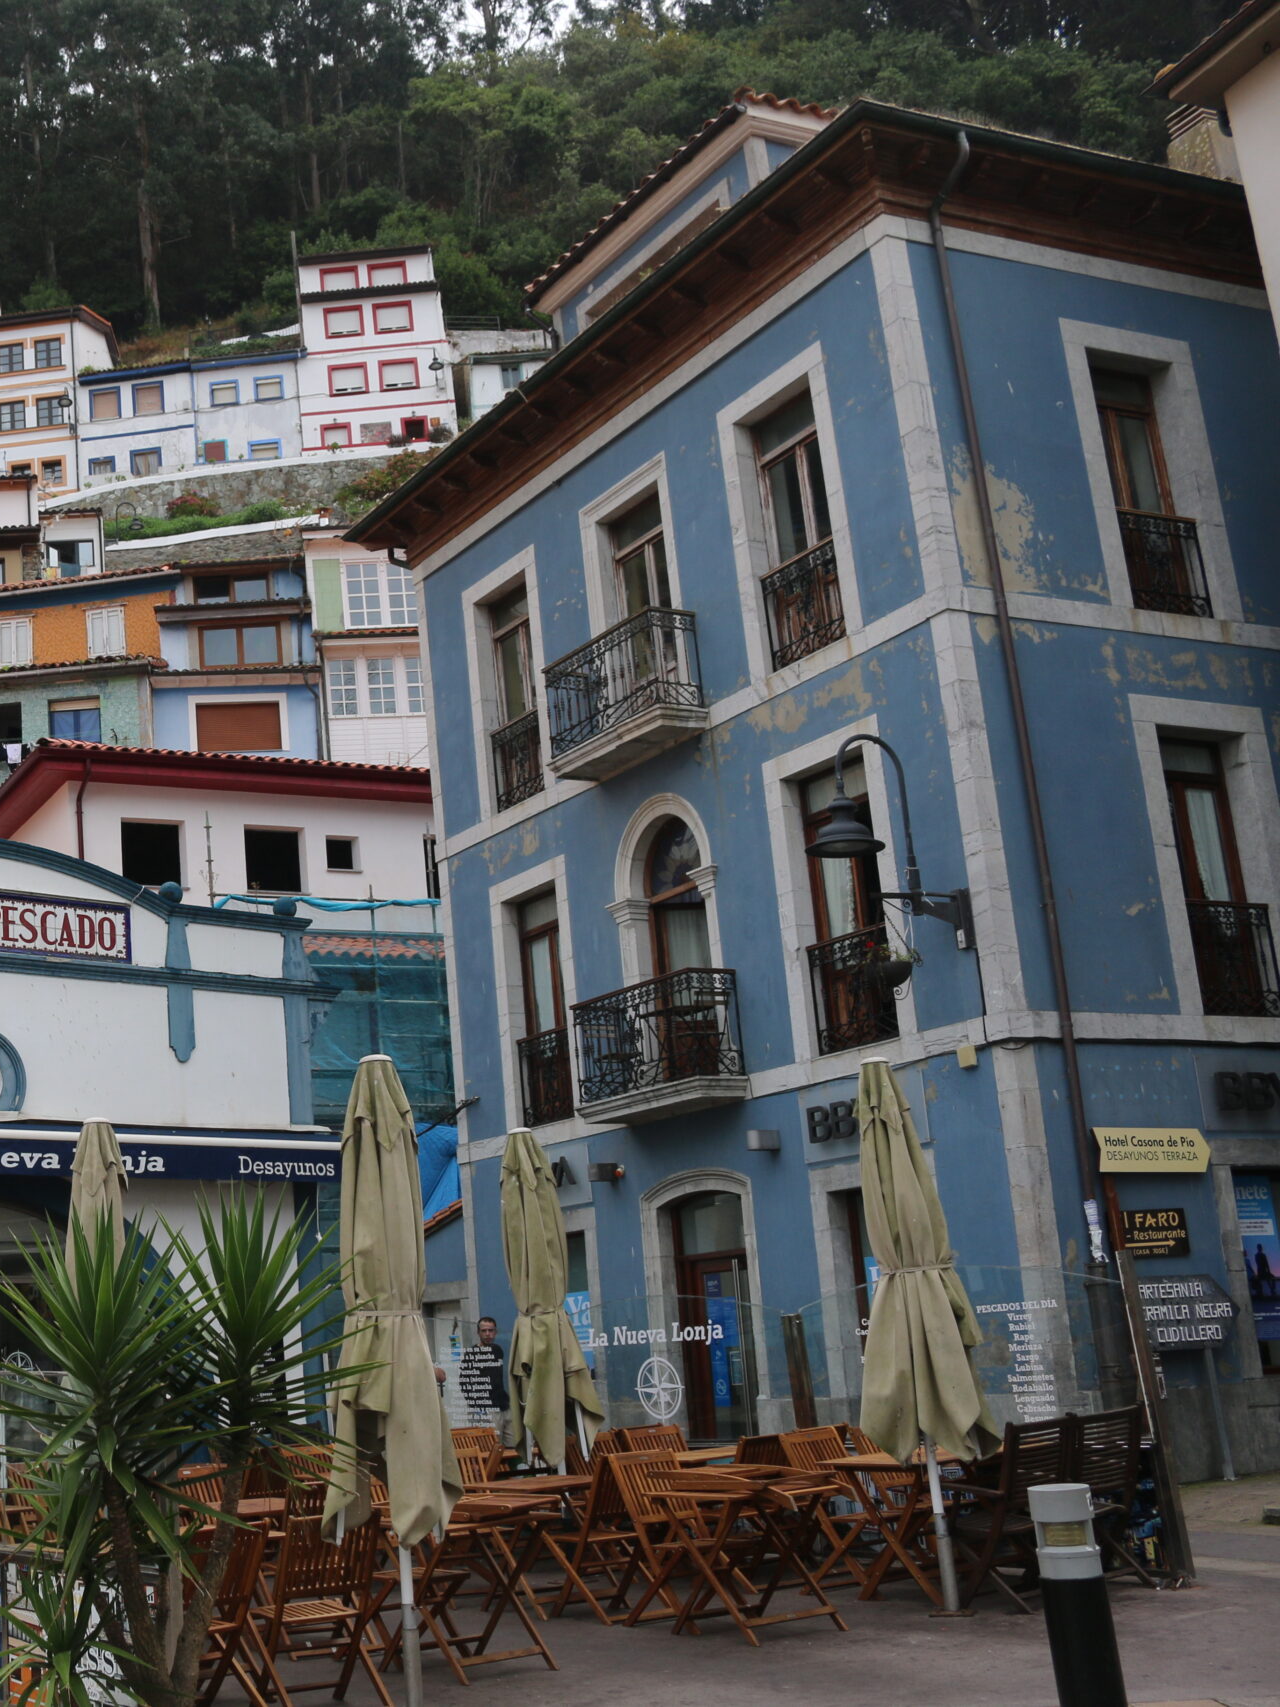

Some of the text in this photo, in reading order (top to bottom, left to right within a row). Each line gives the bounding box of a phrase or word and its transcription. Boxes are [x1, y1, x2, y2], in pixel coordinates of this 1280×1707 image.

[806, 1098, 857, 1144] BB
[1104, 1135, 1129, 1147] Hotel
[1131, 1135, 1164, 1148] Casona
[1167, 1135, 1178, 1148] de
[1106, 1150, 1199, 1161] DESAYUNOS TERRAZA
[238, 1155, 335, 1178] Desayunos
[1134, 1211, 1179, 1228] FARO
[1133, 1228, 1186, 1240] Restaurante
[976, 1301, 1021, 1313] PESCADOS
[1021, 1300, 1040, 1310] DEL
[1143, 1302, 1233, 1320] RAMICA NEGRA
[1007, 1313, 1032, 1322] Virrey
[588, 1328, 609, 1347] La
[613, 1325, 667, 1346] Nueva
[671, 1319, 724, 1345] Lonja
[1013, 1333, 1034, 1342] Rape
[1157, 1325, 1223, 1343] CUDILLERO
[1008, 1343, 1043, 1352] Merluza
[1016, 1353, 1040, 1363] Sargo
[1014, 1363, 1044, 1372] Lubina
[1007, 1373, 1055, 1382] Salmonetes
[1012, 1383, 1054, 1393] Rodaballo
[1014, 1394, 1055, 1404] Lenguado
[1017, 1404, 1057, 1413] Cabracho
